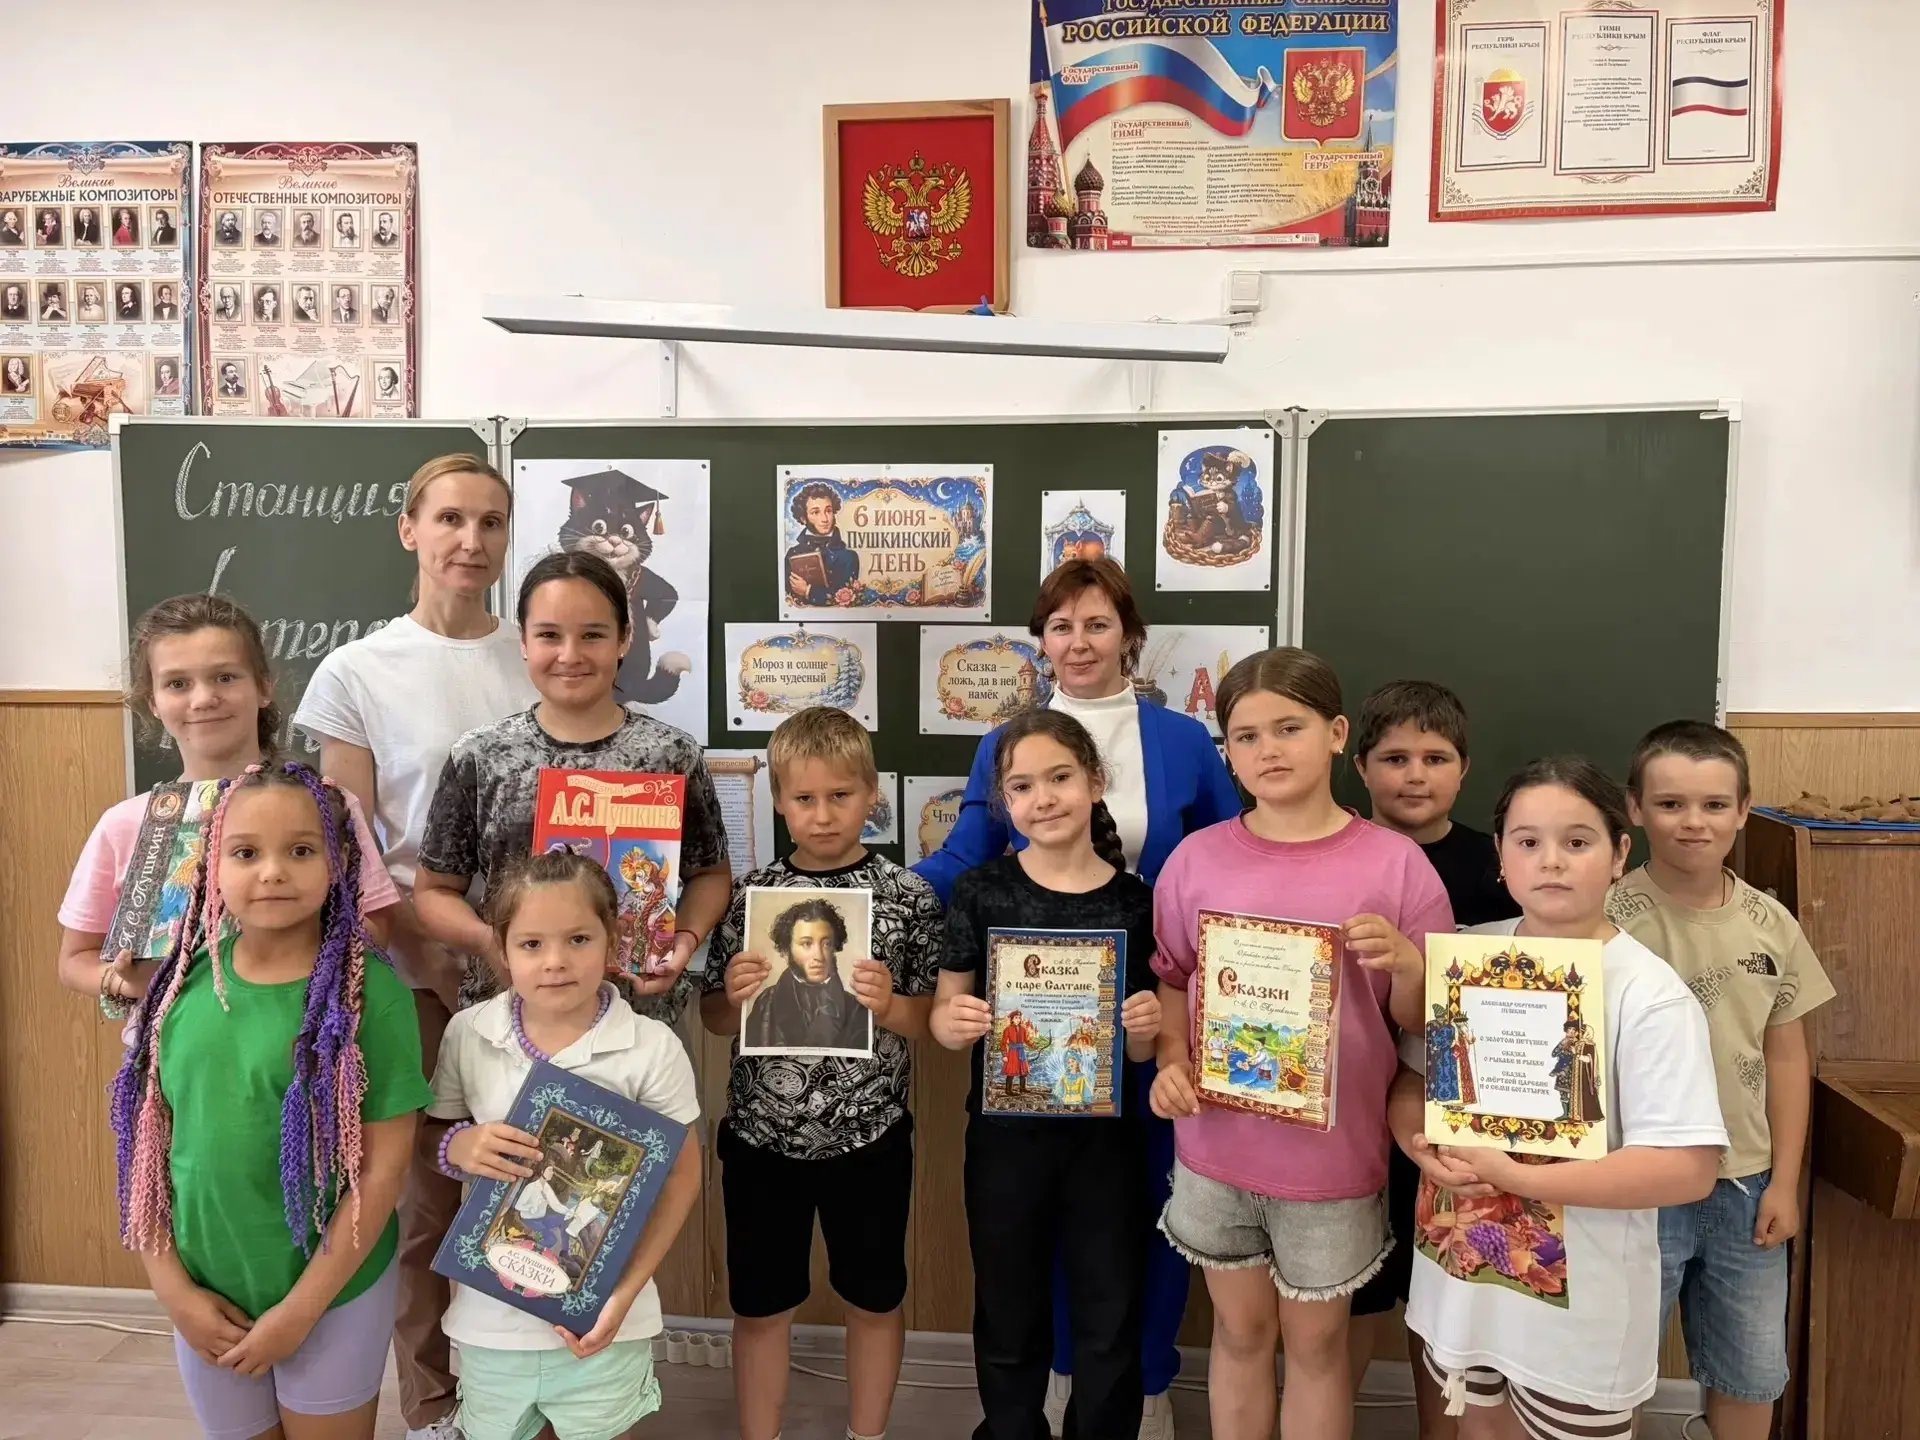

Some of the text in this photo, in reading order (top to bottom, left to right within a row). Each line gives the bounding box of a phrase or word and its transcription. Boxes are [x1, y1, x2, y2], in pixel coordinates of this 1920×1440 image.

[1064, 12, 1387, 41] РОССИЙСКОЙ ФЕДЕРАЦИИ
[1062, 62, 1139, 75] Государственный
[1062, 74, 1089, 84] ФЛАГ
[1112, 120, 1190, 129] Государственный
[1112, 129, 1143, 138] ГИМН
[1304, 152, 1383, 163] Государственный
[1304, 161, 1330, 170] ГЕРБ
[57, 174, 116, 188] Великие
[277, 175, 338, 189] Великие
[79, 188, 178, 202] КОМПОЗИТОРЫ
[213, 192, 402, 205] ОТЕЧЕСТВЕННЫЕ КОМПОЗИТОРЫ
[175, 441, 411, 524] Станция
[853, 505, 869, 528] 6
[874, 509, 926, 527] ИЮНЯ
[847, 528, 951, 549] ПУШКИНСКИЙ
[868, 553, 926, 575] ДЕНЬ
[752, 658, 785, 671] Мороз
[787, 660, 793, 669] и
[795, 660, 828, 671] солнце
[956, 658, 997, 672] Сказка
[754, 671, 827, 685] день чудесный
[948, 675, 1017, 688] ложь, да в ней
[968, 688, 999, 700] намёк
[932, 809, 957, 823] Что
[131, 826, 167, 908] Пушкин
[1737, 958, 1768, 967] NORTH
[1750, 952, 1766, 960] THE
[1023, 953, 1080, 978] Сказка
[1746, 966, 1767, 975] FACE
[1005, 979, 1096, 993] о царе Салтане,
[1217, 966, 1290, 1001] Сказки
[497, 1254, 557, 1289] СКАЗКИ
[521, 1255, 556, 1275] ПУШКИН
